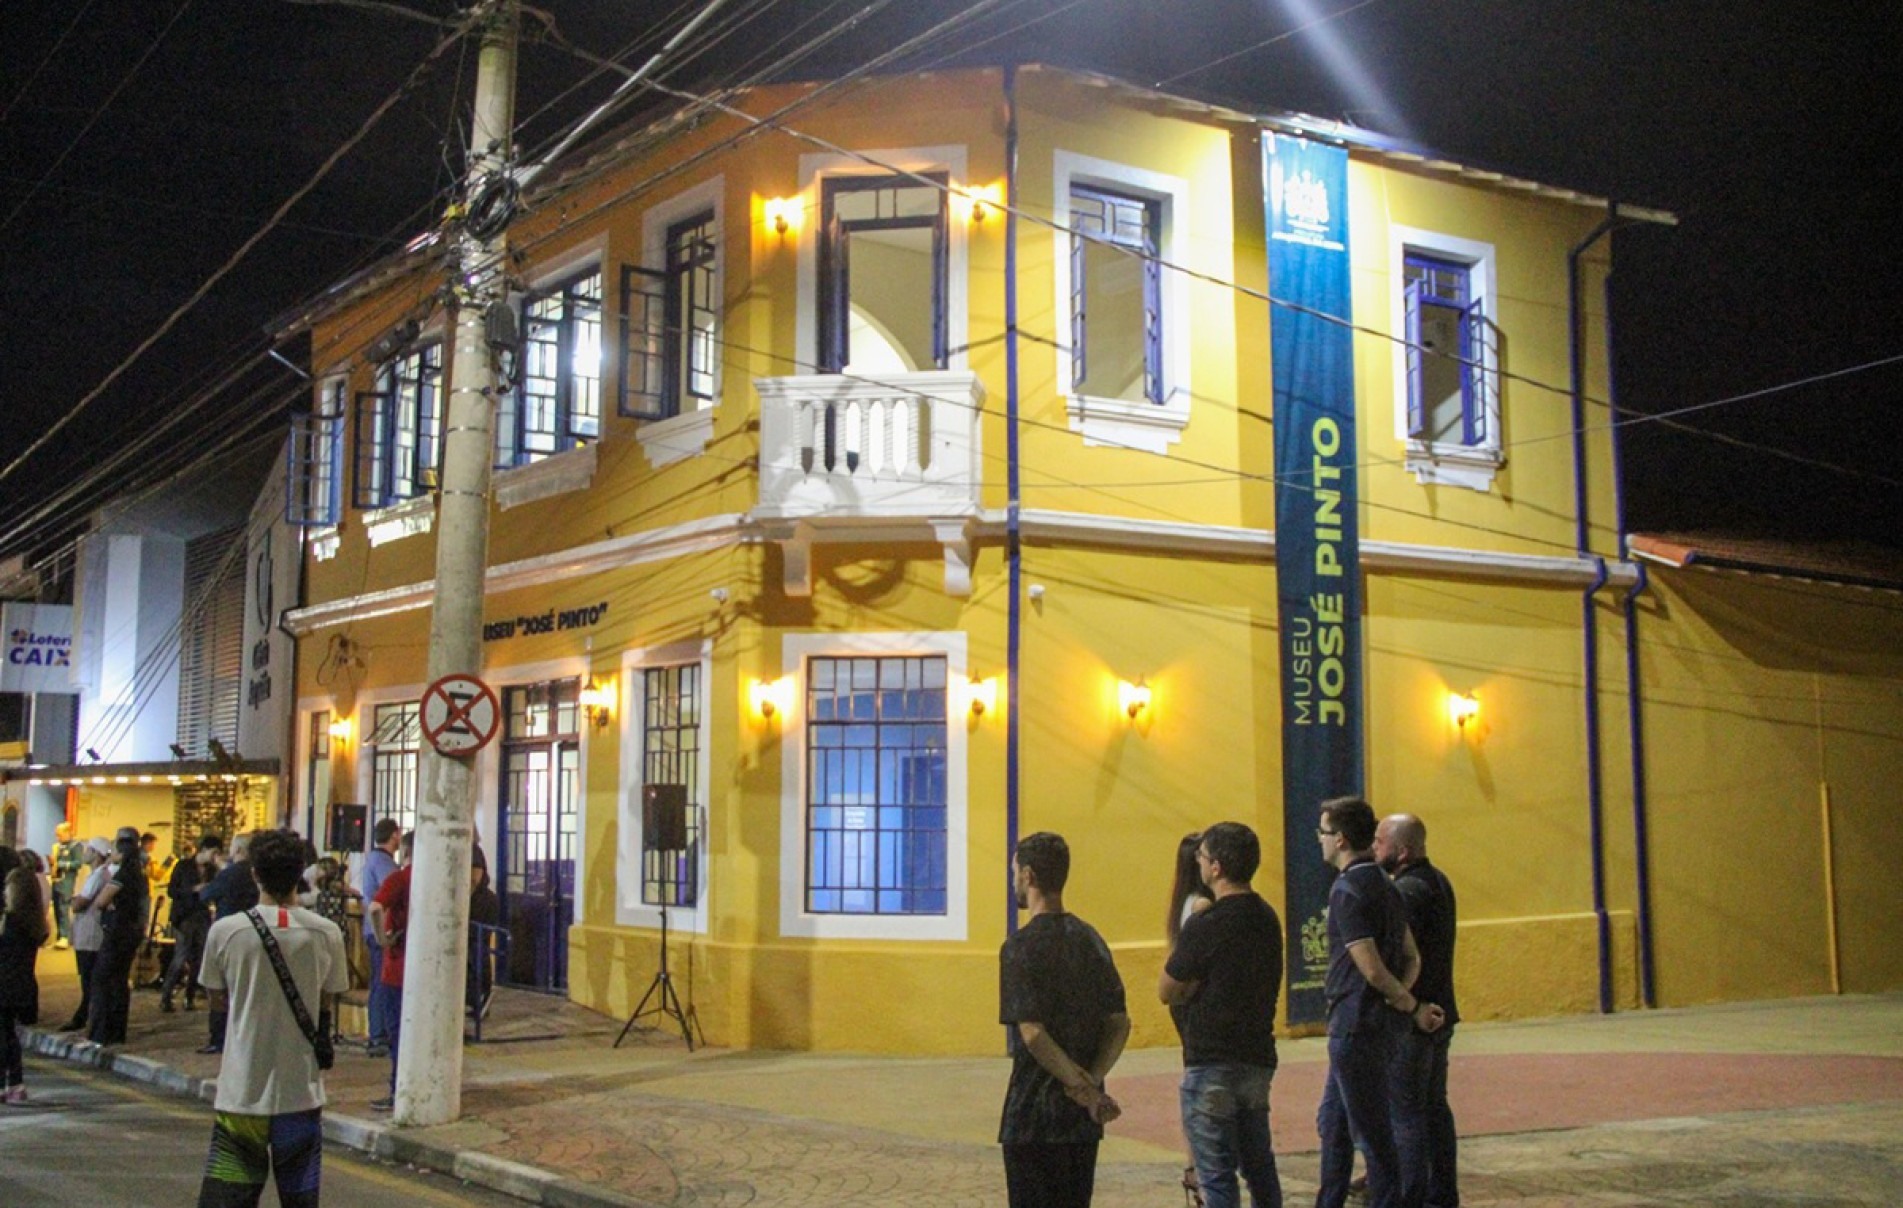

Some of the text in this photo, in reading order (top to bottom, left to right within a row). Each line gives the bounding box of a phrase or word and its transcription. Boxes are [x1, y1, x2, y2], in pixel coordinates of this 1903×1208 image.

[1311, 416, 1345, 726] JOSÉ PINTO
[9, 647, 71, 666] CAIX
[483, 620, 515, 641] USEU
[1293, 617, 1313, 725] MUSEU
